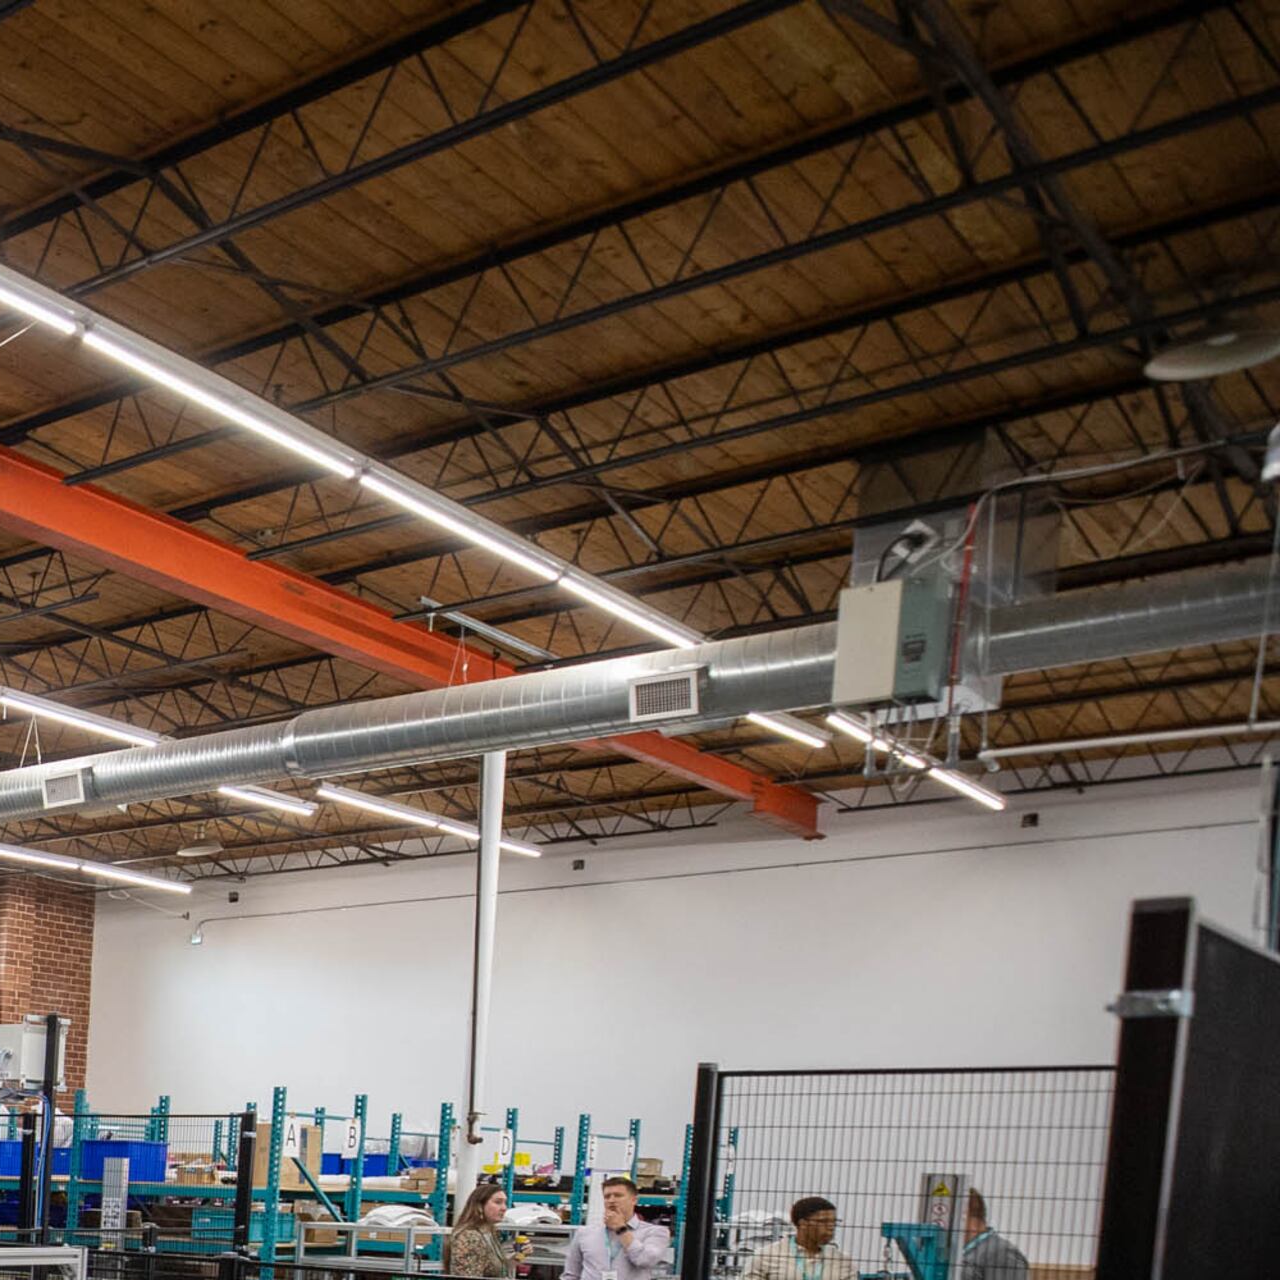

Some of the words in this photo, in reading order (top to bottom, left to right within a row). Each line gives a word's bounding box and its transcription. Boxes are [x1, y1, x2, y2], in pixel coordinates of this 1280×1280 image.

[286, 1123, 297, 1148] A
[347, 1126, 357, 1149] B
[501, 1136, 511, 1156] D
